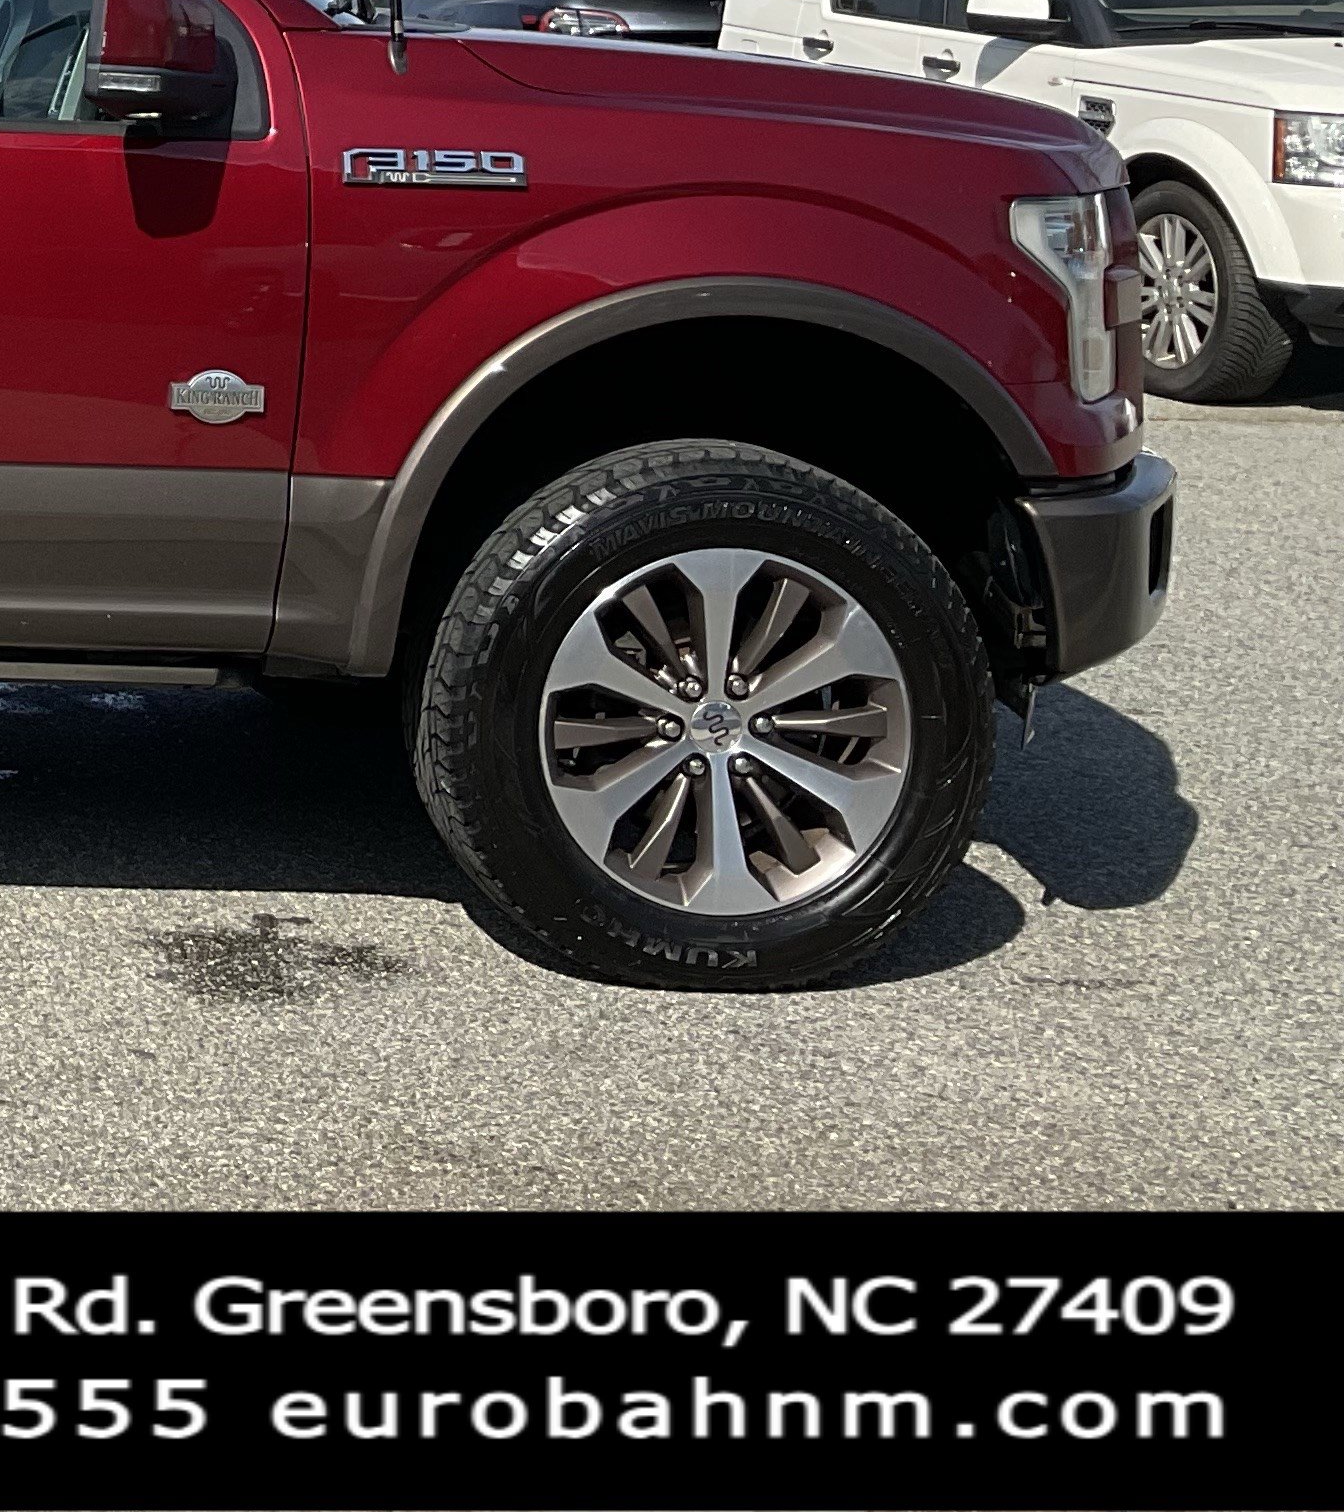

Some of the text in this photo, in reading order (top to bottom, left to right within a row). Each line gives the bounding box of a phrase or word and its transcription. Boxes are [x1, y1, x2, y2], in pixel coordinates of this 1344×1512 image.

[175, 388, 260, 407] KING RANCH
[587, 502, 692, 563] MAVIS
[578, 903, 759, 970] KUMHO
